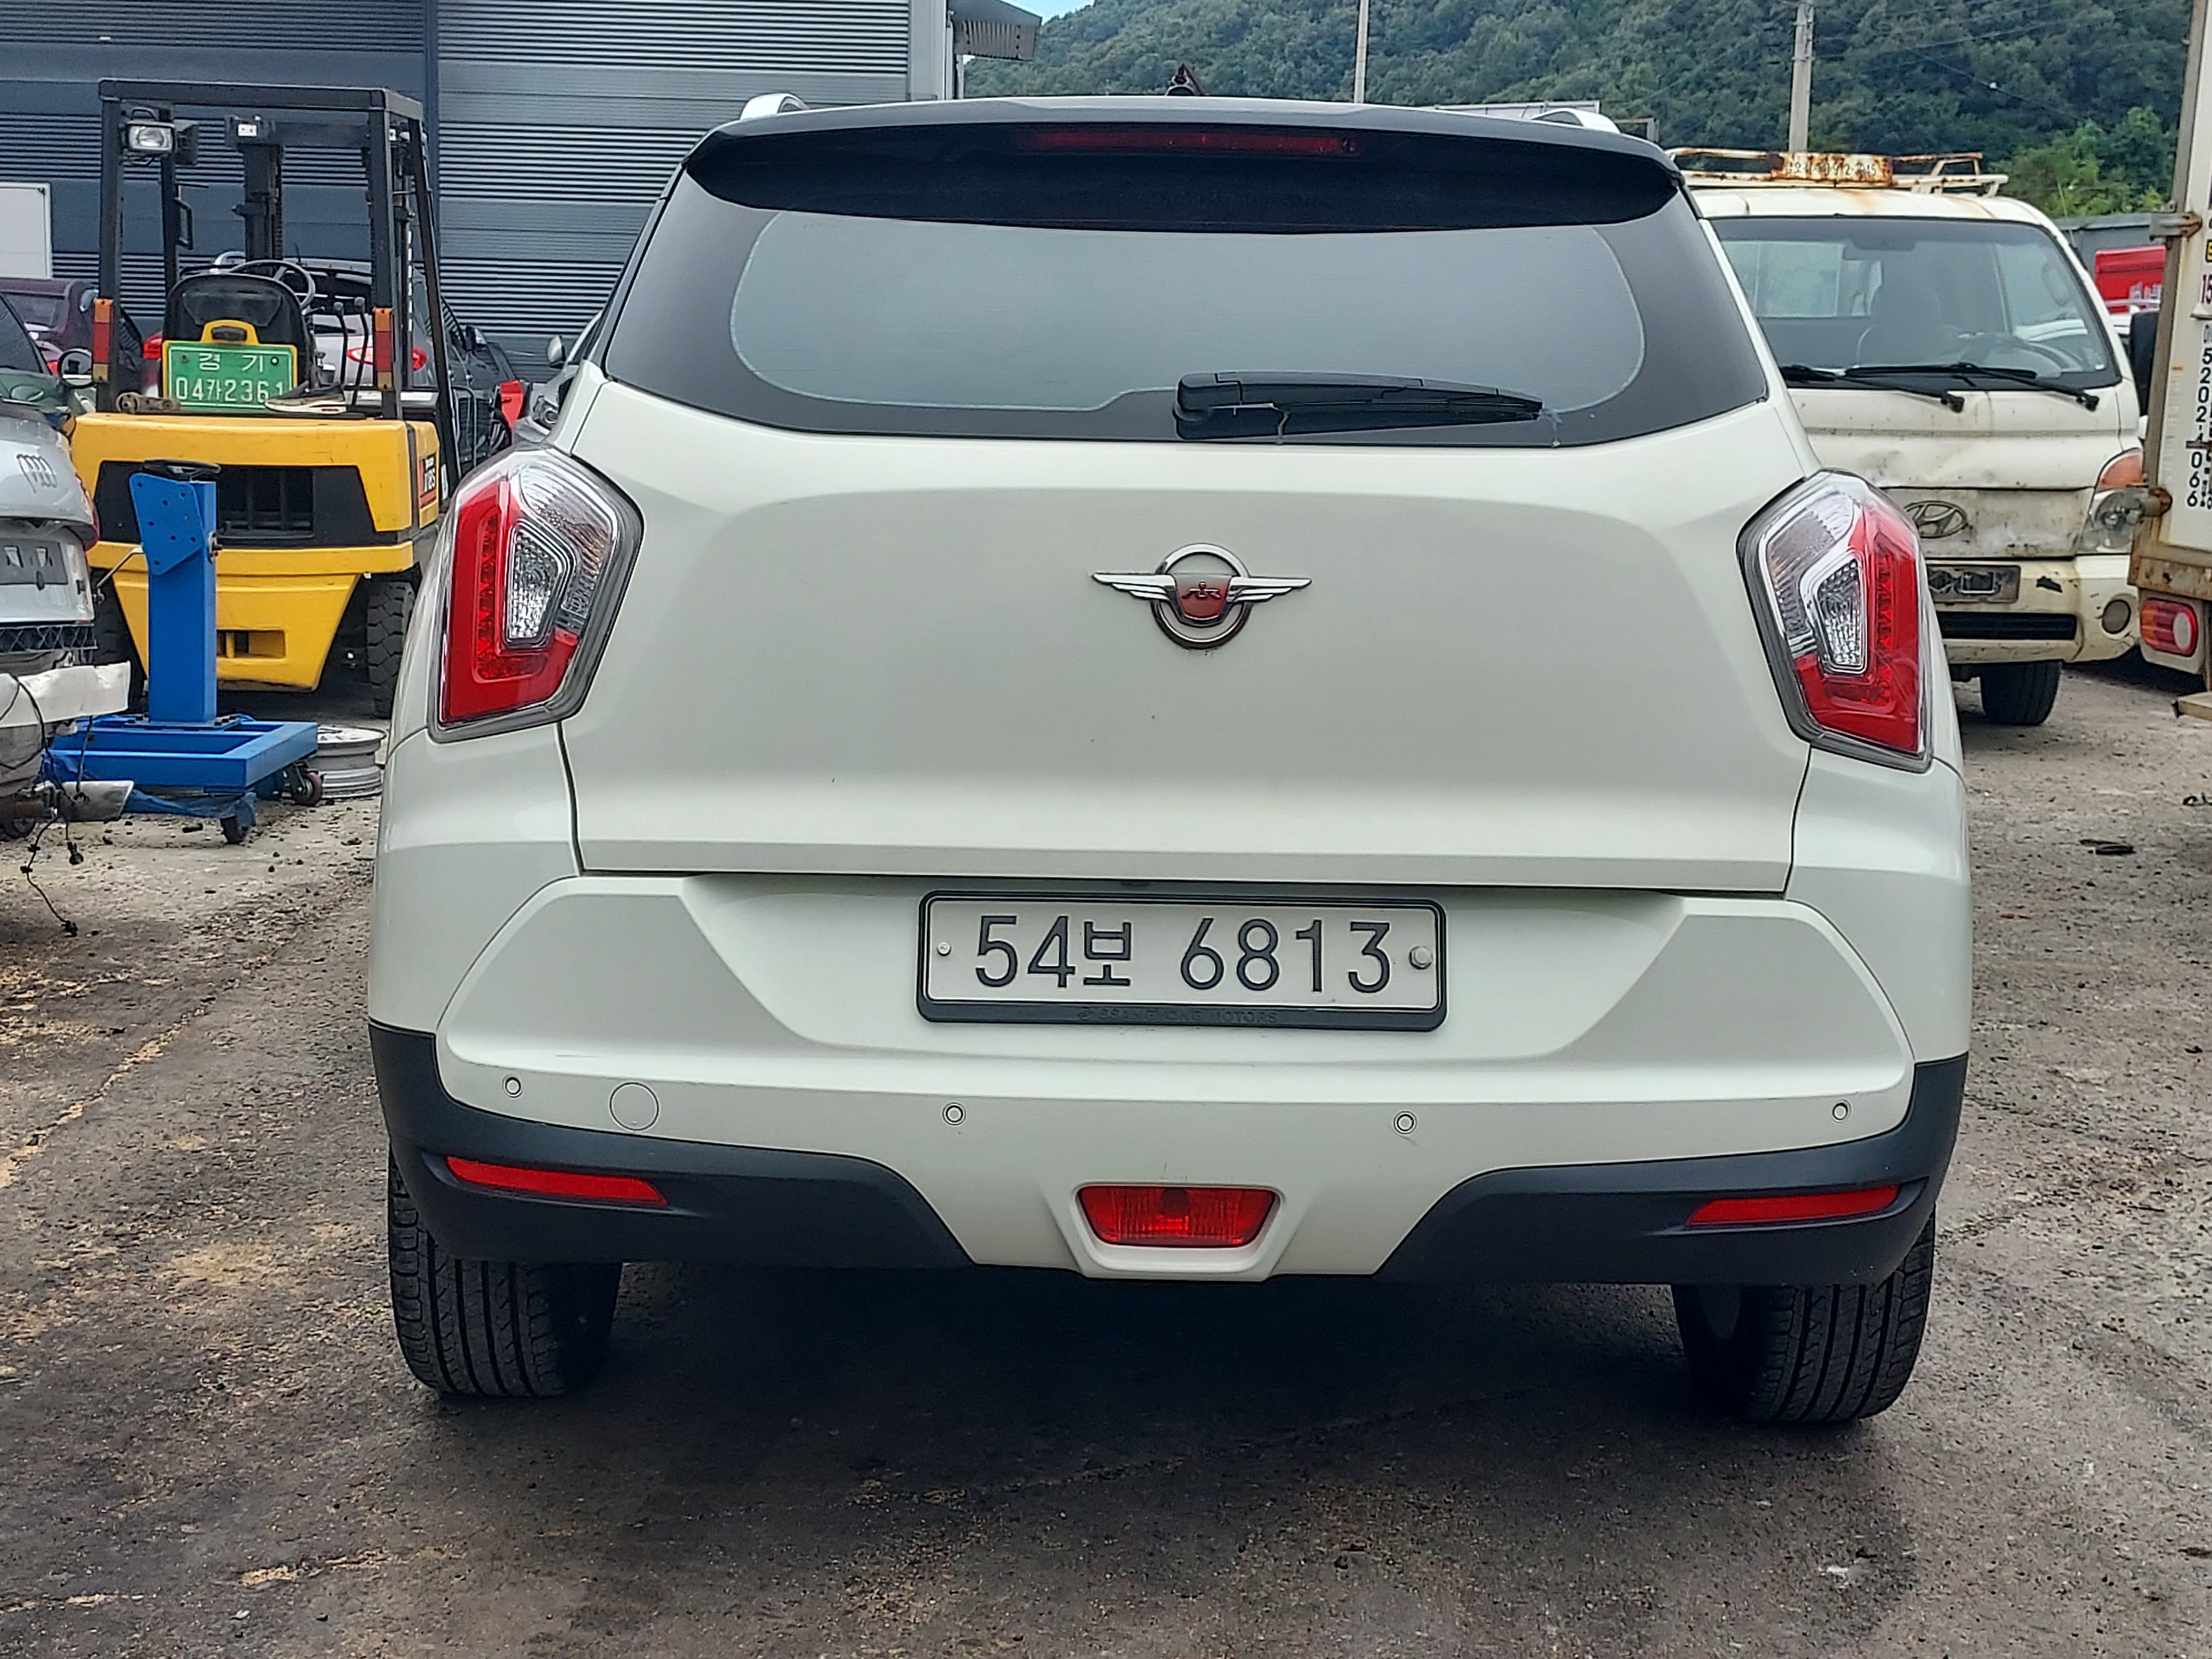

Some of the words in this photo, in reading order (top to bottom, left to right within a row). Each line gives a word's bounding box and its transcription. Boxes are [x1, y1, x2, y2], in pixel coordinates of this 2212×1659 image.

[199, 352, 264, 373] 경기
[975, 915, 1131, 988] 54보
[1180, 917, 1390, 994] 6813
